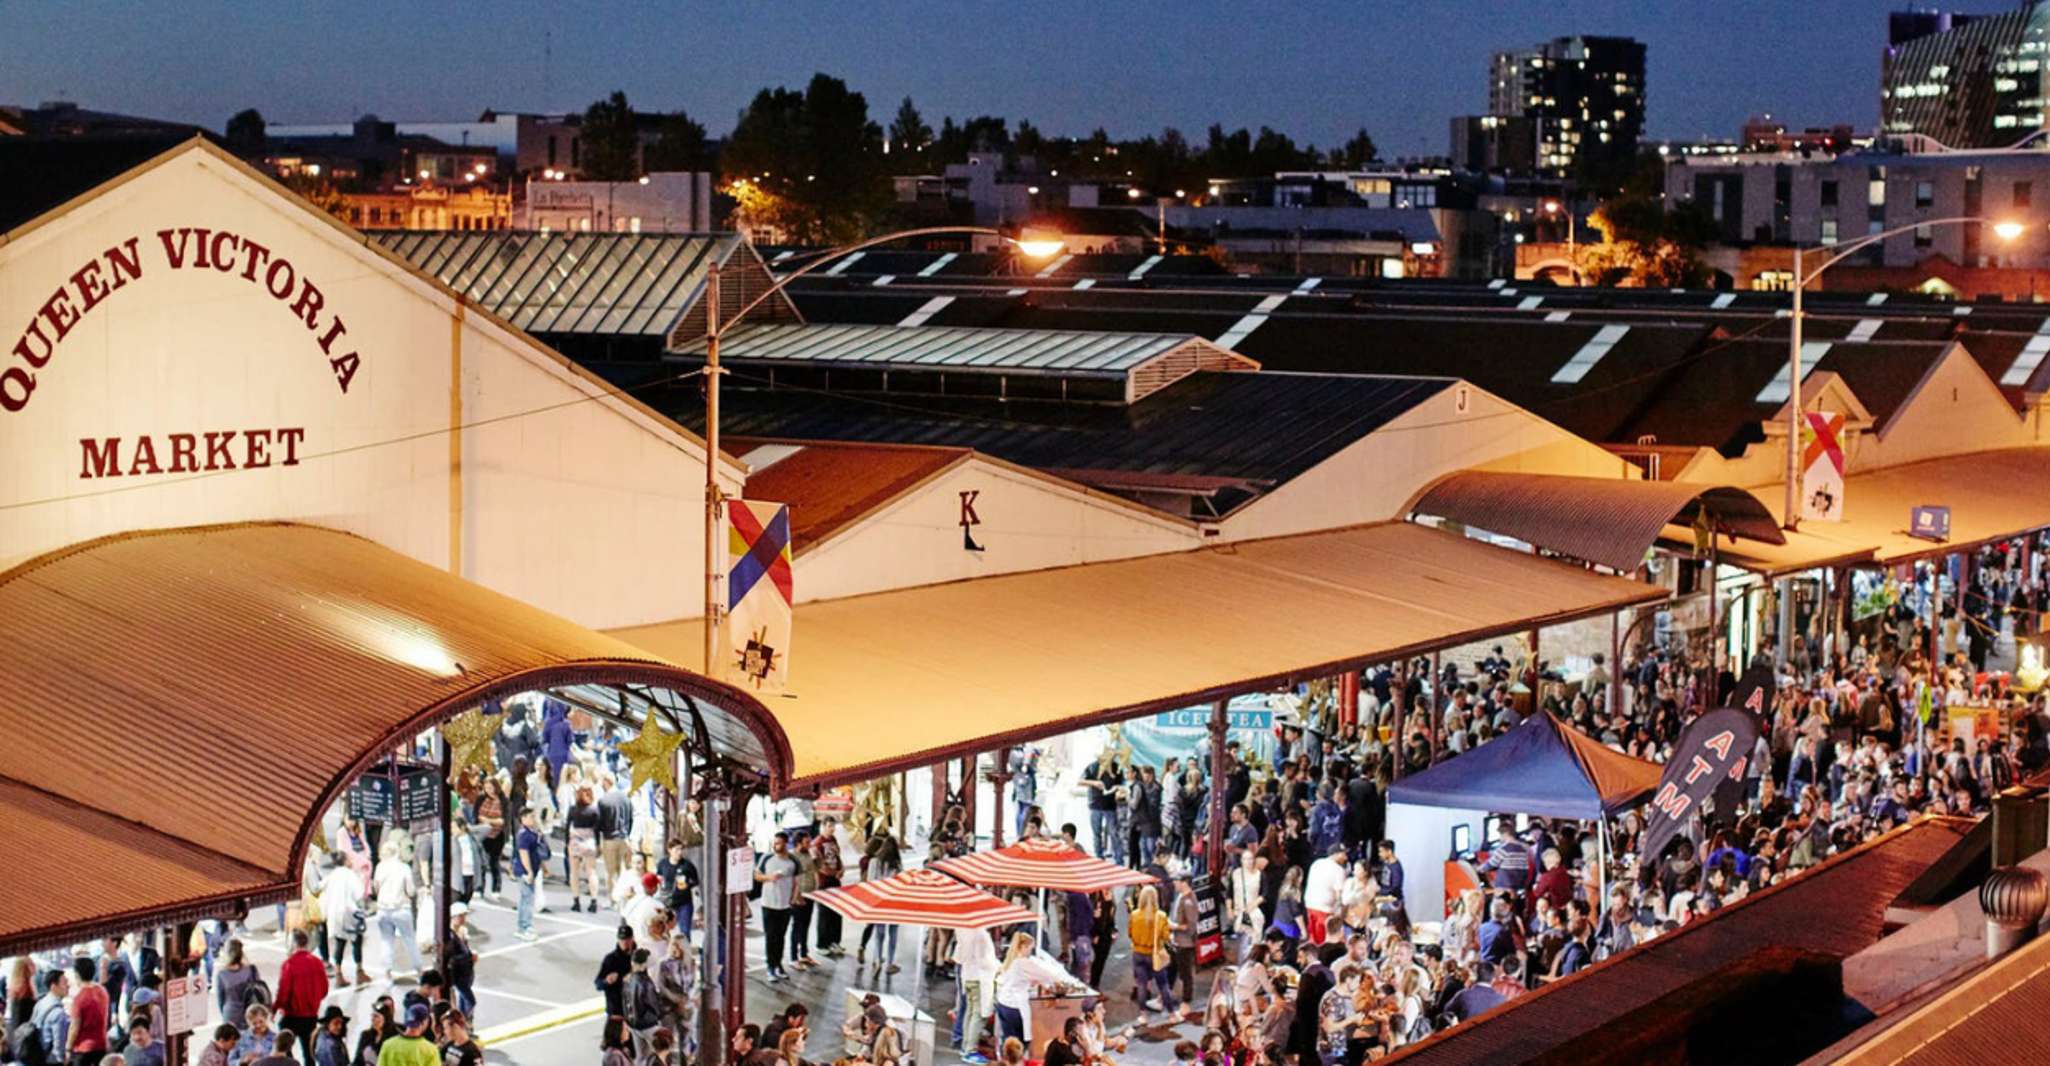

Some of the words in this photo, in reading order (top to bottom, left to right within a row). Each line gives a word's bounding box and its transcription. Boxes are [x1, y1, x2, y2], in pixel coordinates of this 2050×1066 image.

[0, 237, 143, 412] QUEEN
[156, 227, 361, 394] VICTORIA
[1458, 389, 1466, 411] J
[79, 427, 305, 479] MARKET
[958, 490, 981, 526] K
[1654, 730, 1735, 821] ATM
[193, 978, 201, 995] S
